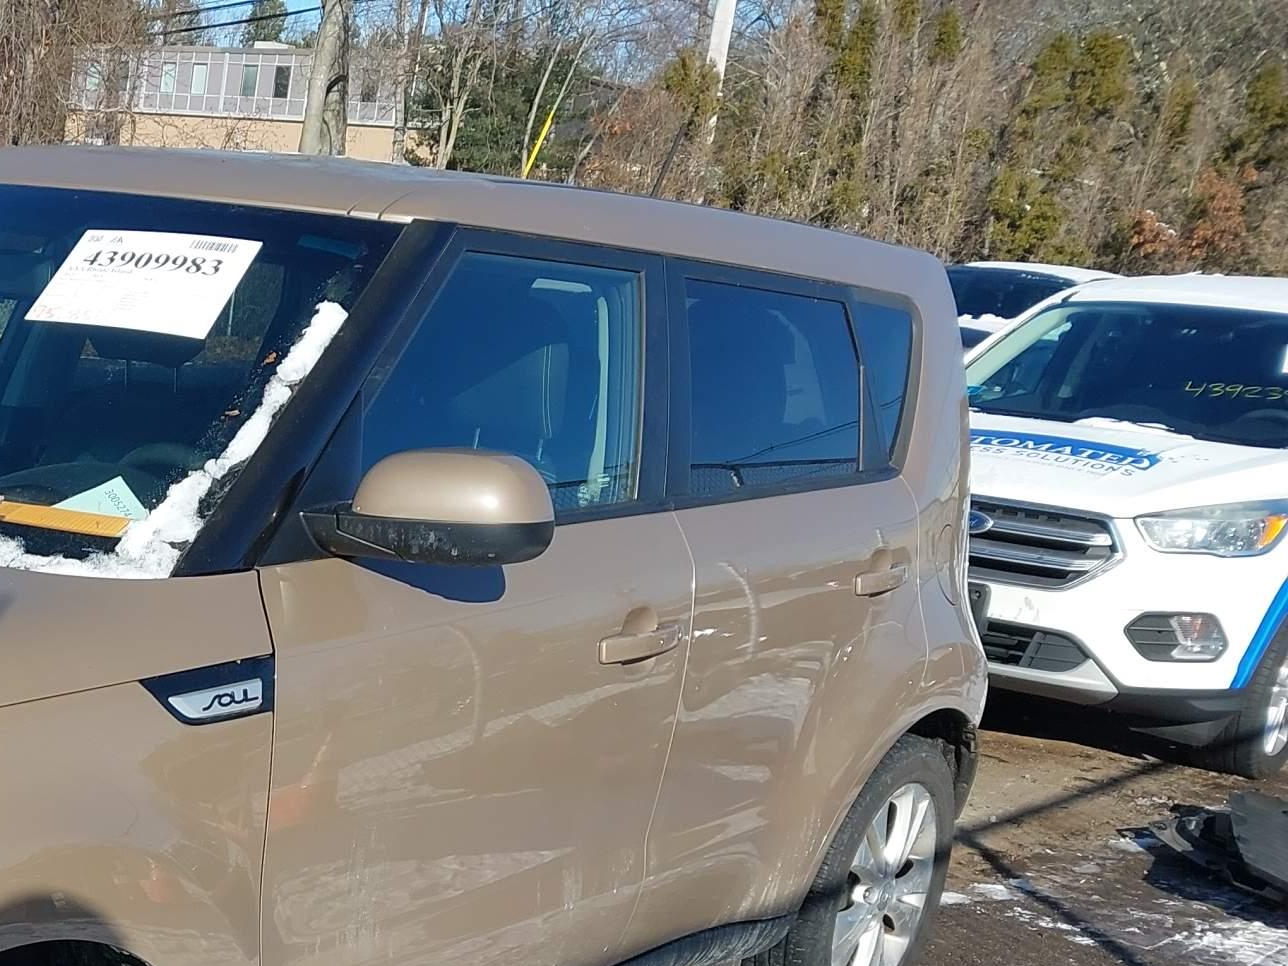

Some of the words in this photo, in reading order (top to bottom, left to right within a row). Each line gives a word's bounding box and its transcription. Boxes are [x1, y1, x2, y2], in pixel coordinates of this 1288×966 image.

[82, 249, 224, 277] 43909983
[1015, 449, 1136, 477] SOLUTIONS
[201, 688, 260, 712] SOUL
